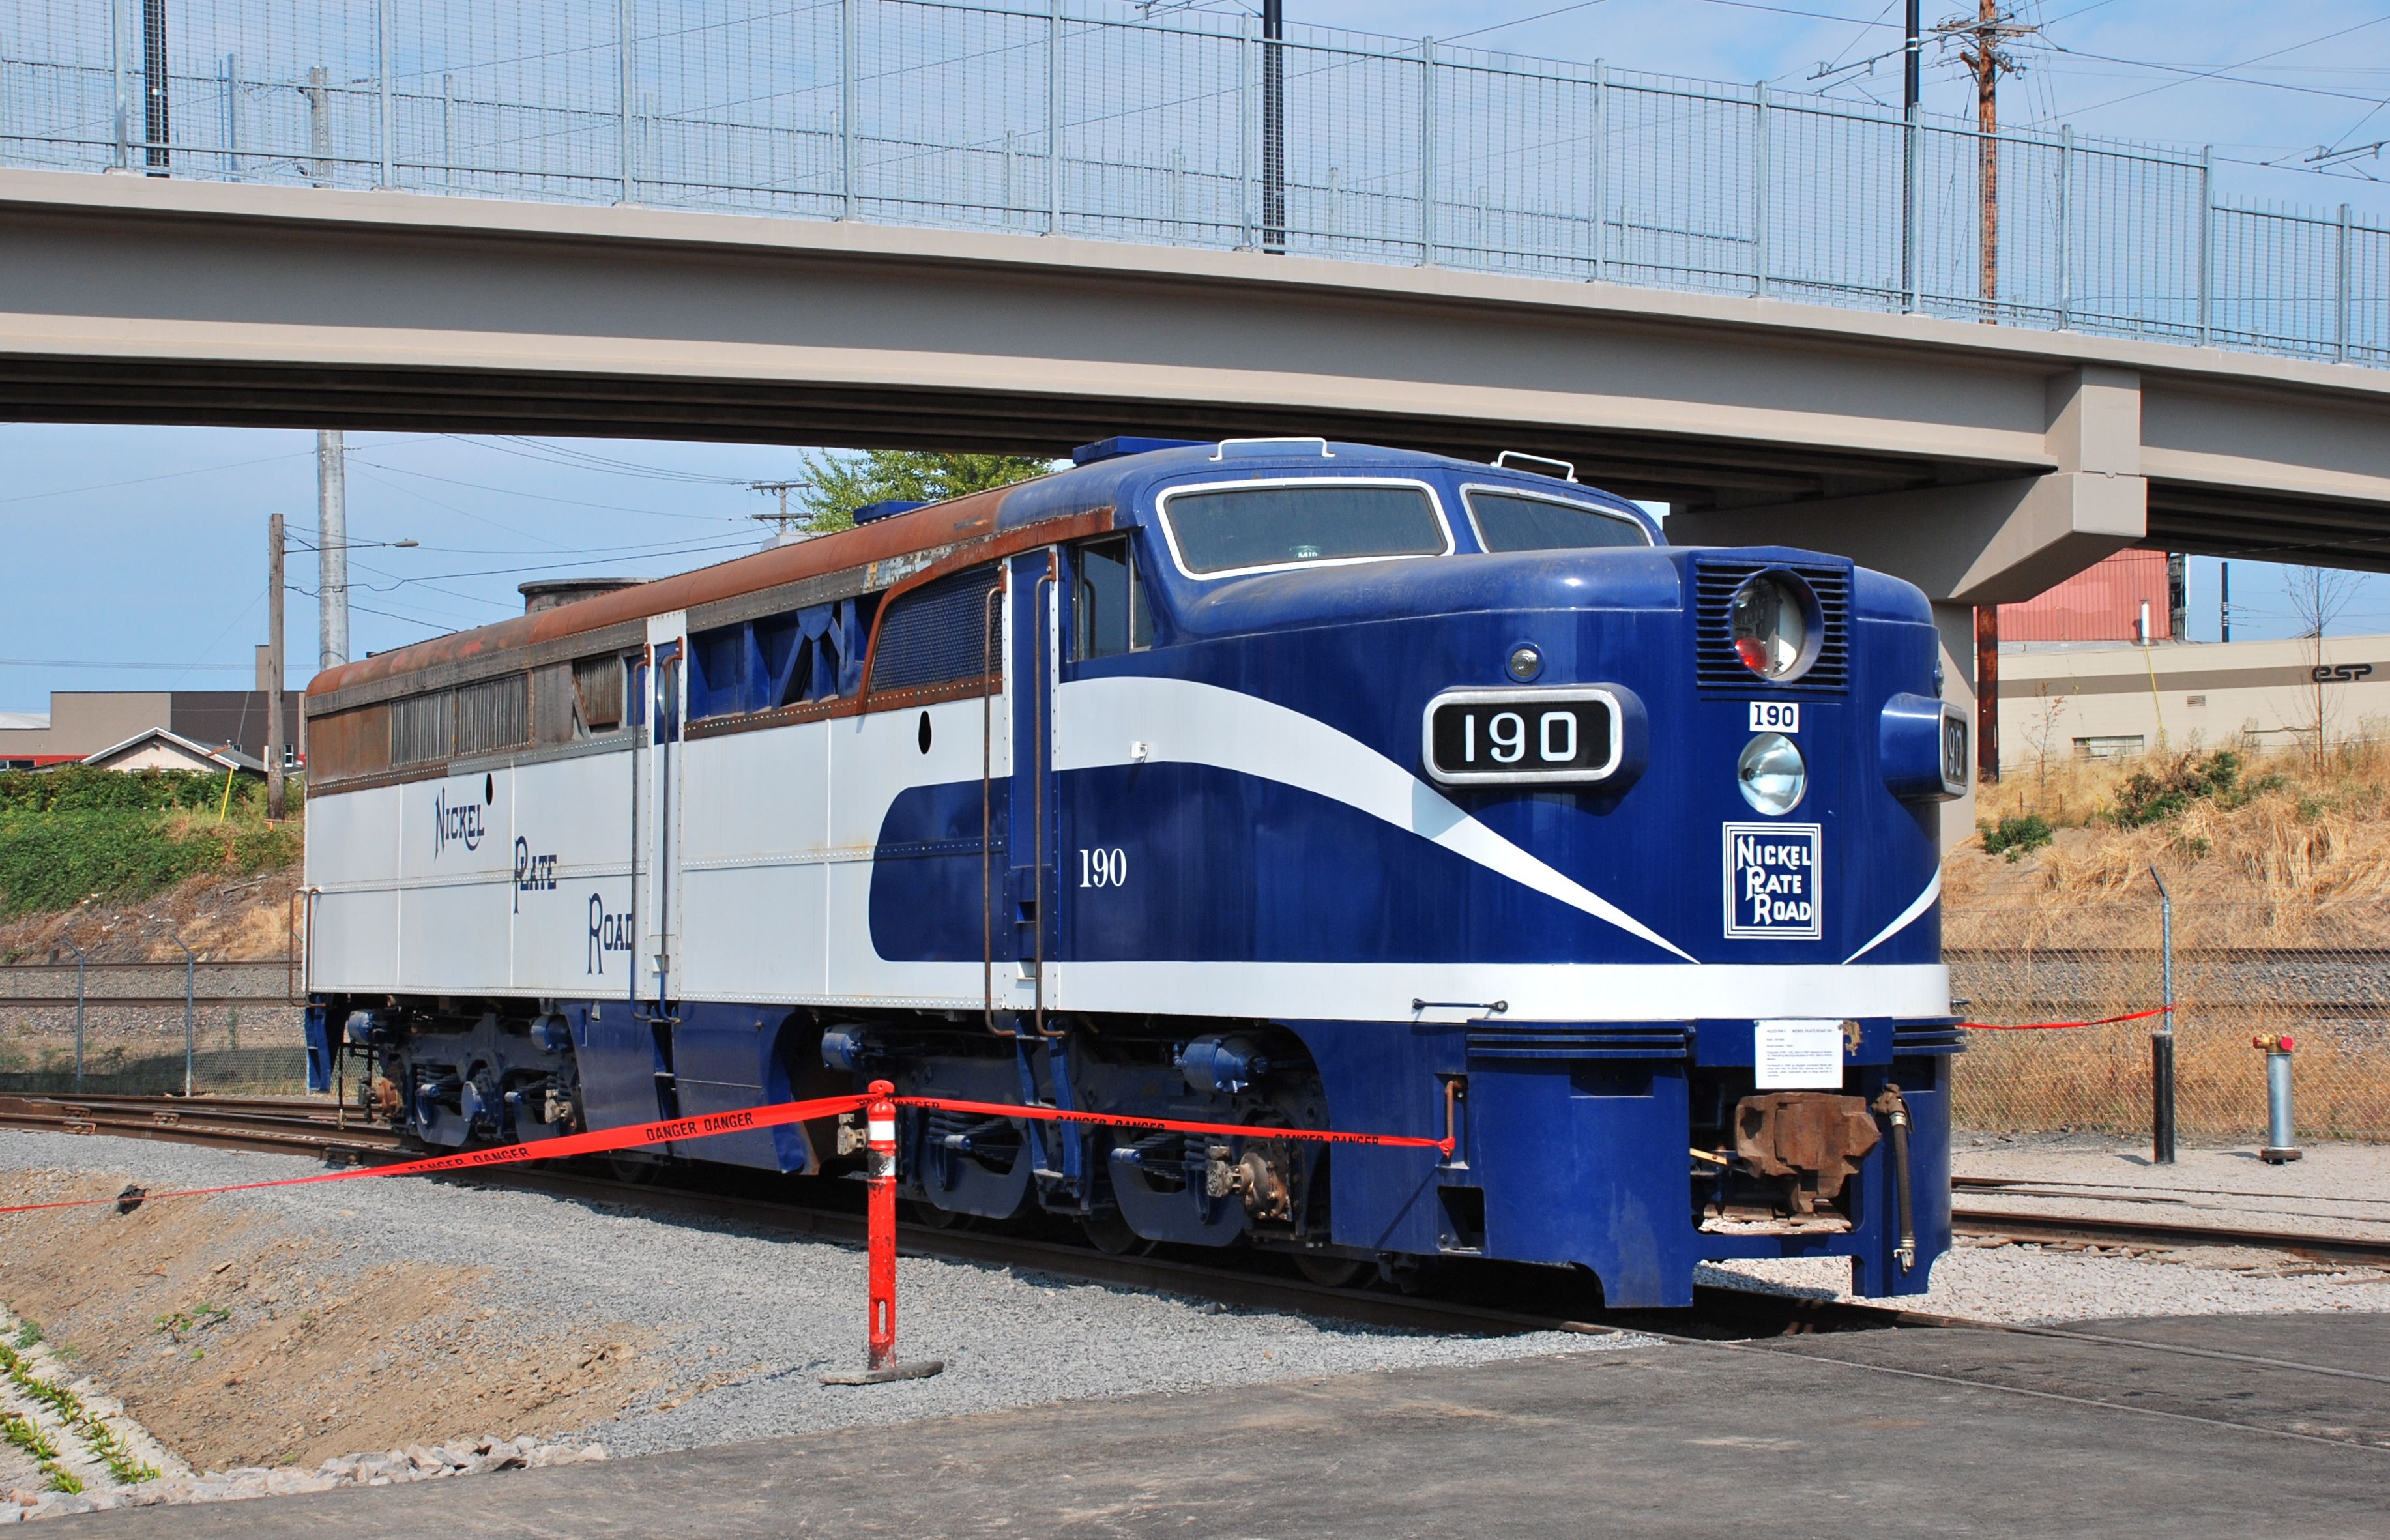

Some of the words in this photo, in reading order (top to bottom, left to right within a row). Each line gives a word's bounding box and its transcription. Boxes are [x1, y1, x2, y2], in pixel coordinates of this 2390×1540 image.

[1755, 705, 1794, 727] 190
[1465, 711, 1577, 763] 190
[435, 786, 485, 863] NICKEL
[1079, 848, 1127, 888] 190
[1736, 835, 1811, 871] NICKEL
[514, 835, 557, 915] PLATE
[1745, 865, 1802, 901] PLATE
[1753, 893, 1811, 925] ROAD
[646, 1122, 698, 1141] DANGER
[703, 1112, 754, 1131] DANGER
[473, 1147, 531, 1163] DANGER
